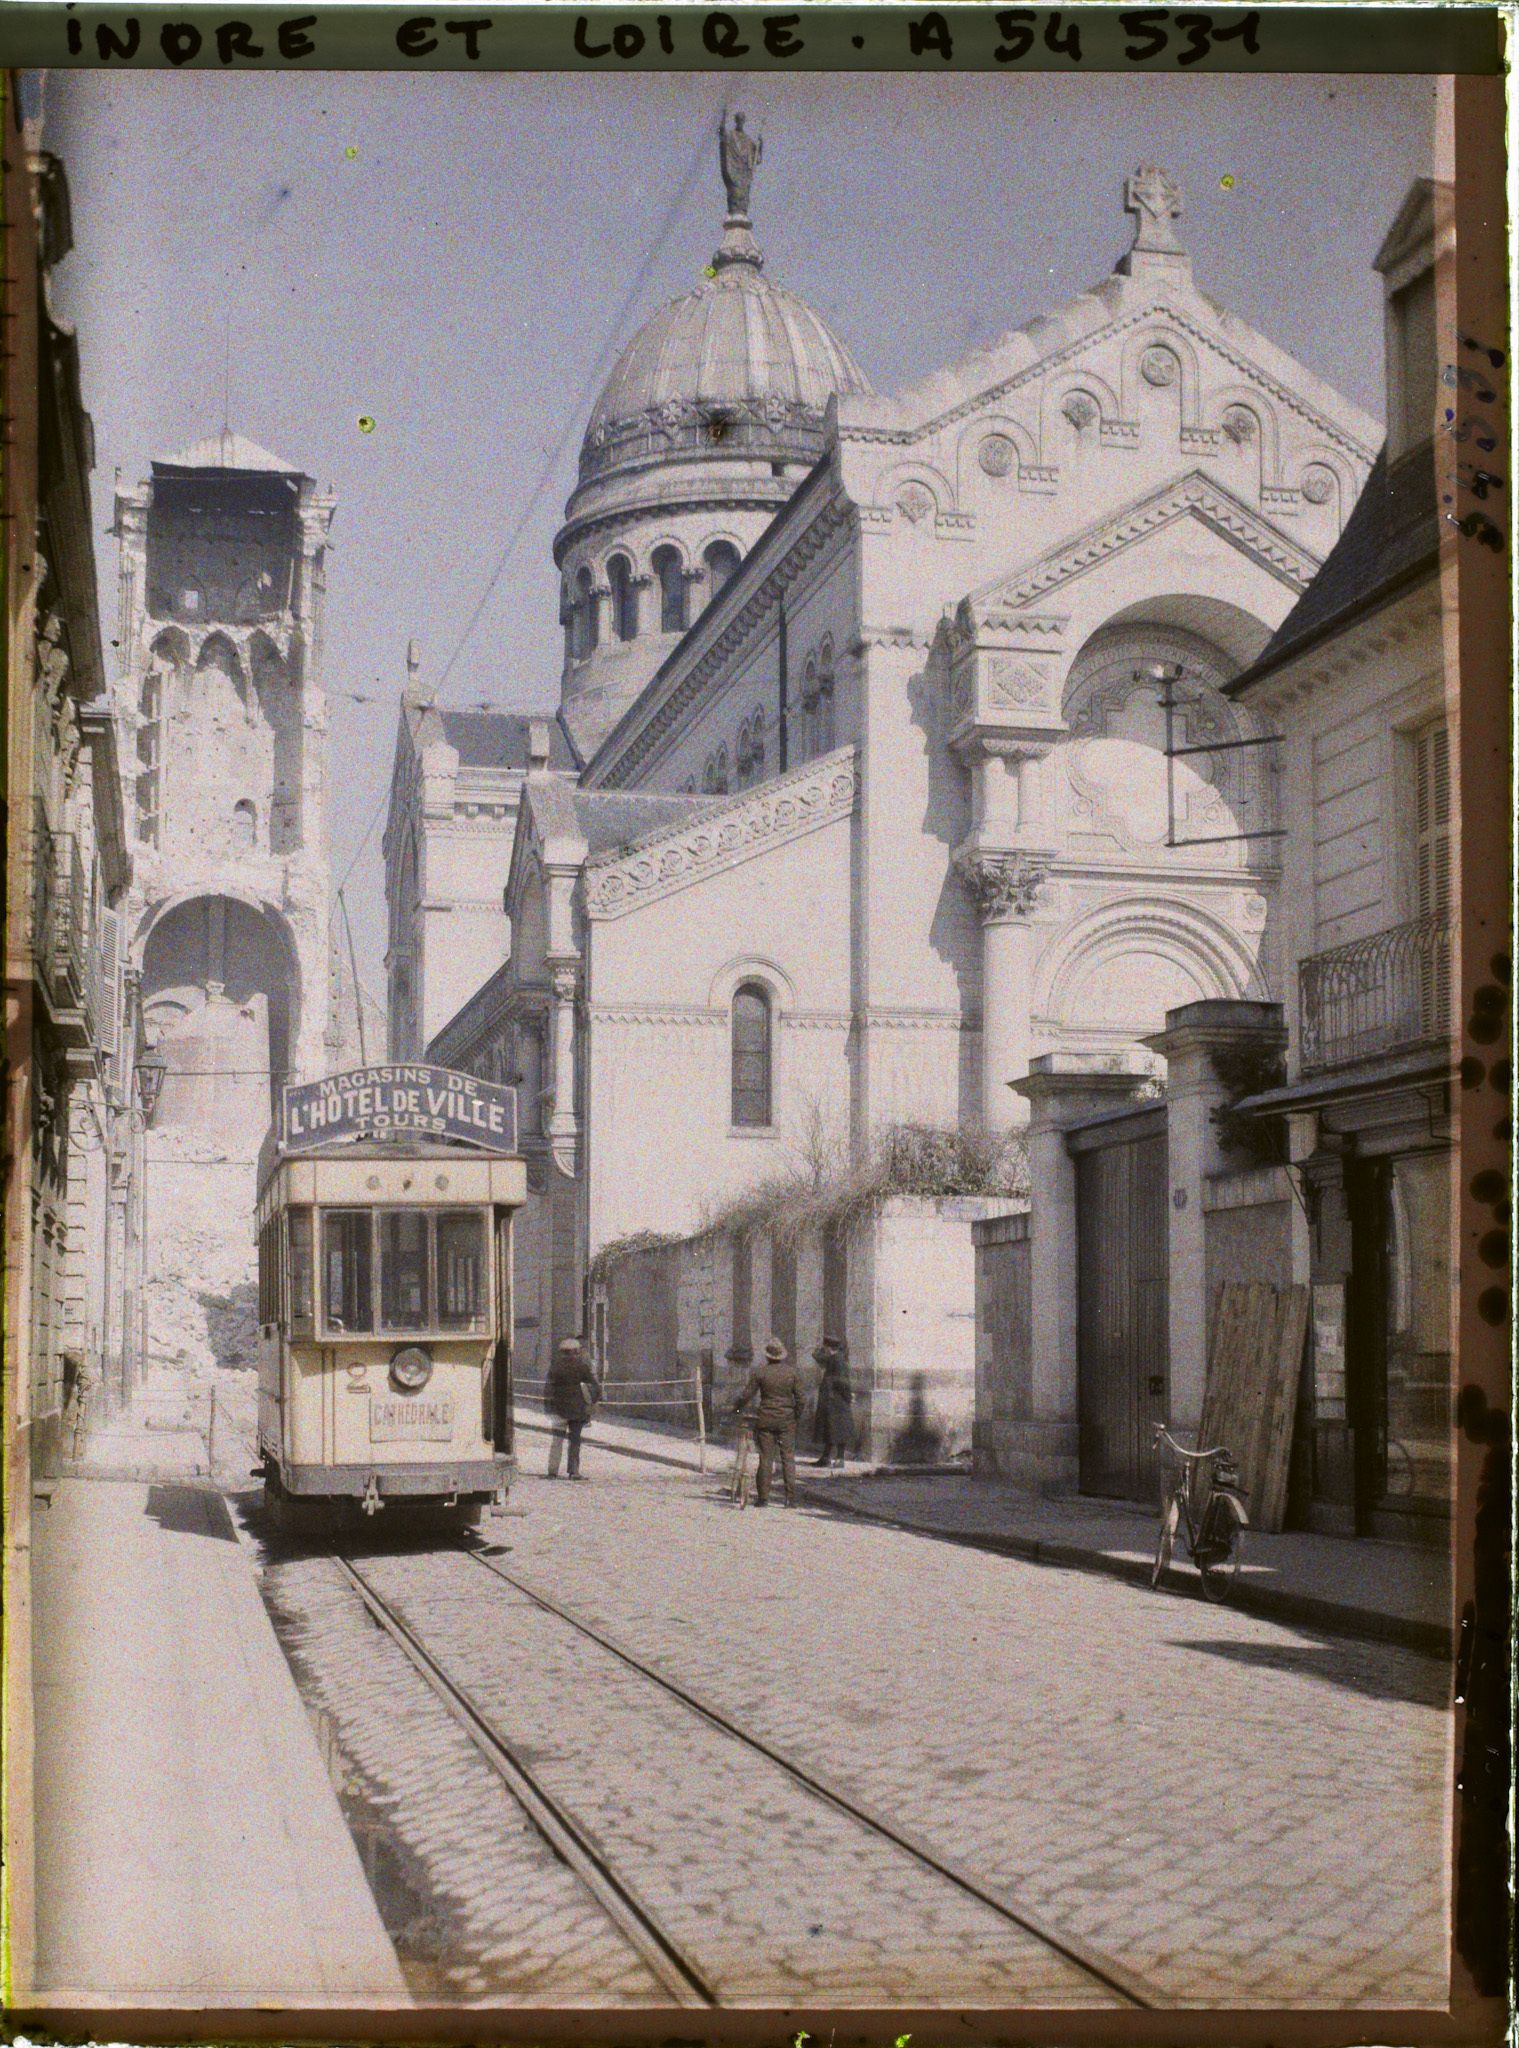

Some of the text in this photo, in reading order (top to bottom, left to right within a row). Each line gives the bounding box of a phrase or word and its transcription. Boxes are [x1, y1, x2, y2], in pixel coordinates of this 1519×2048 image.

[319, 1068, 478, 1098] MAGASINS DE
[355, 1114, 447, 1131] TOURS
[393, 1088, 421, 1113] DE
[426, 1087, 505, 1135] VILLE
